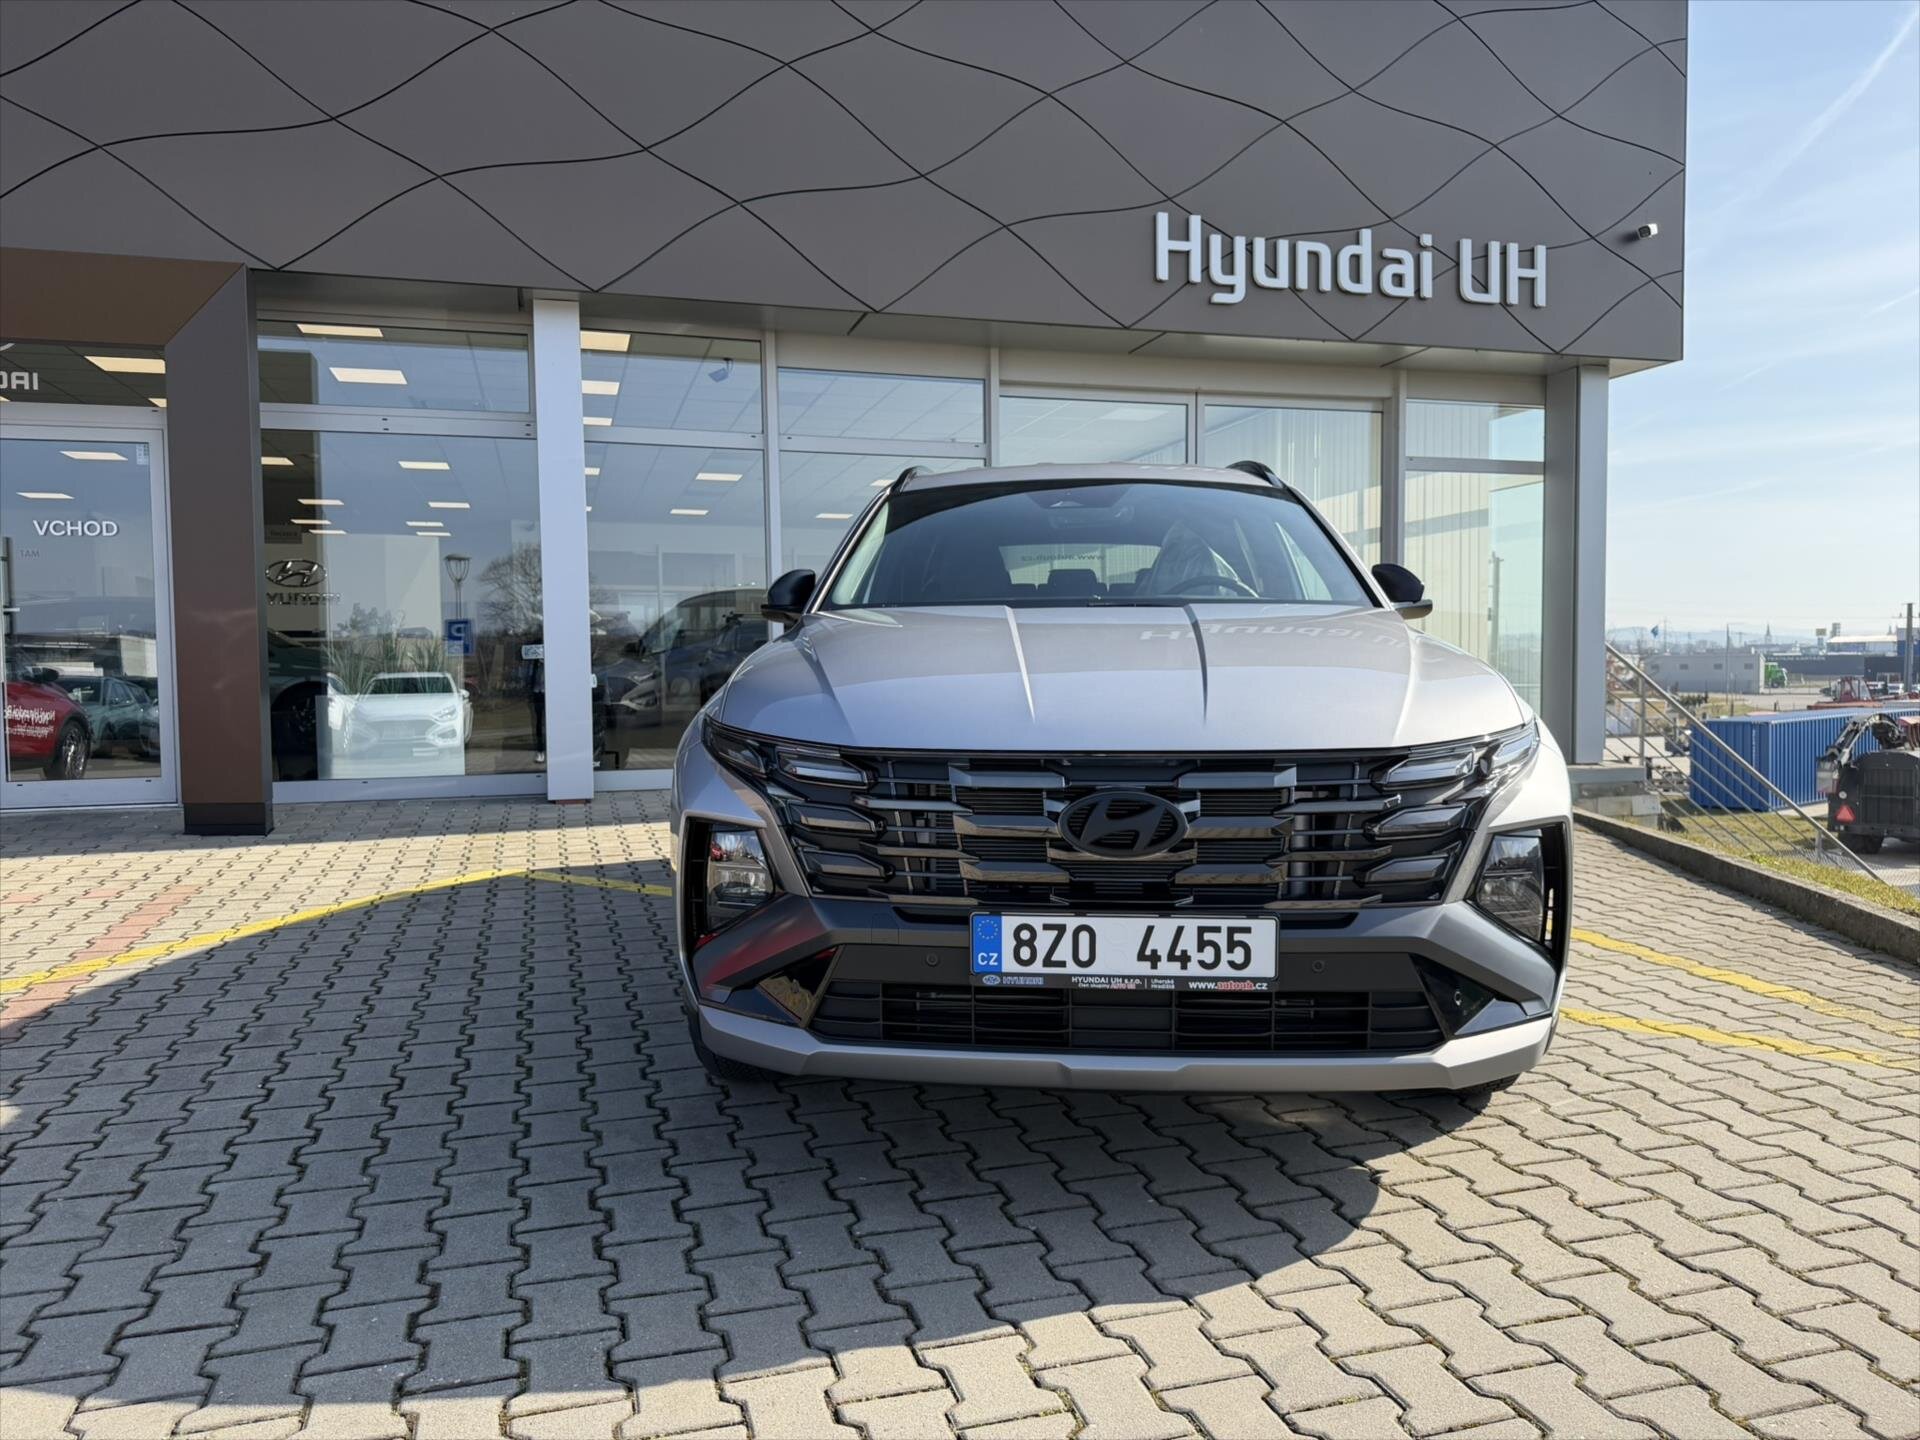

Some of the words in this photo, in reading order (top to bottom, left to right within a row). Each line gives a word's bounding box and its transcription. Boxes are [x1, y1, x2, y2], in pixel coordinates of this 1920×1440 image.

[1155, 211, 1433, 304] Hyundai
[1459, 238, 1547, 307] UH
[33, 520, 119, 536] VCHOD
[1136, 925, 1252, 971] 4455
[978, 952, 999, 966] CZ
[1071, 976, 1109, 984] HYUNDAI
[1188, 980, 1268, 990] www.autouh.cz
